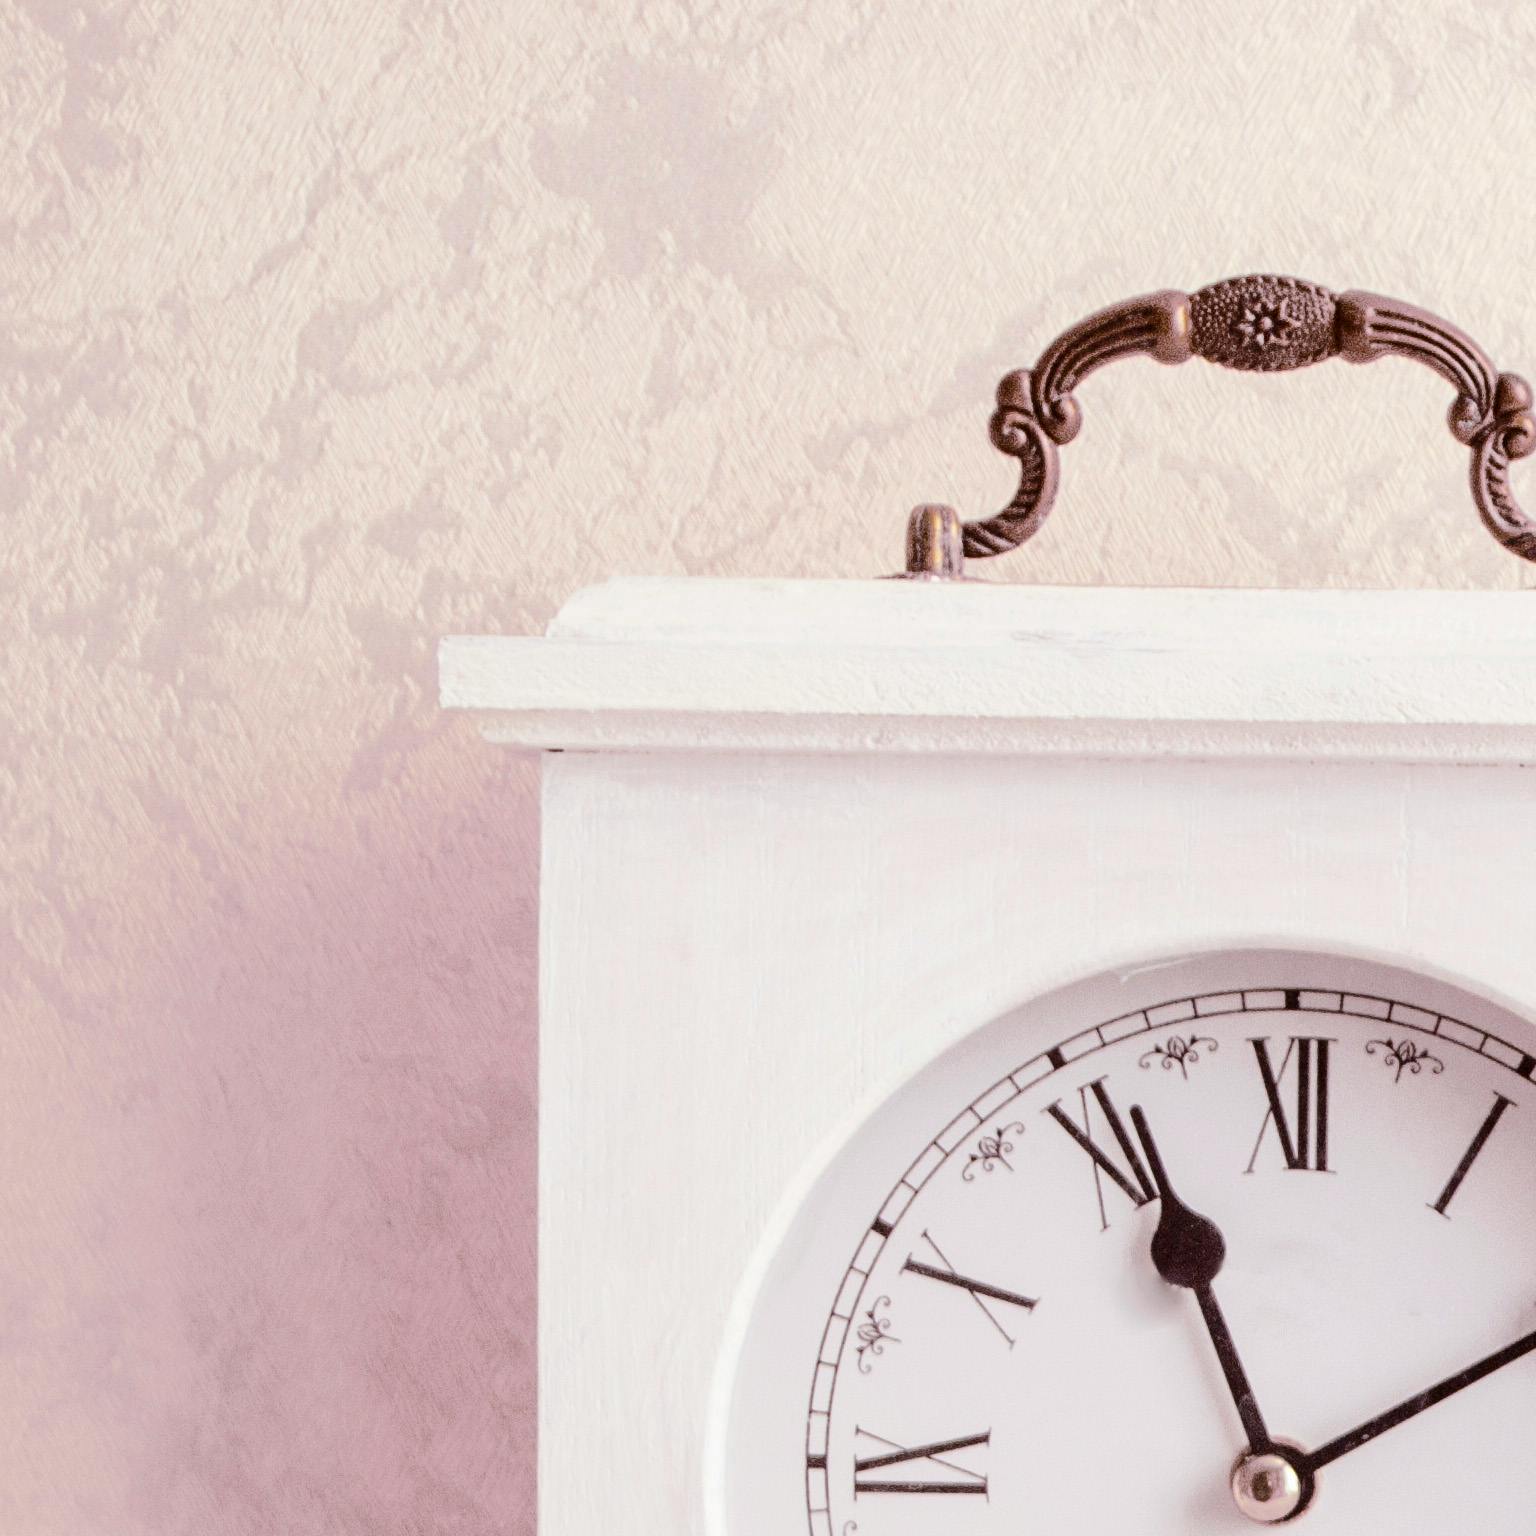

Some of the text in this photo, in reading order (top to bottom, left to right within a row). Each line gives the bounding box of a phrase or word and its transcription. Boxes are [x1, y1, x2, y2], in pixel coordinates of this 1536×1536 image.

[1040, 1075, 1161, 1232] XI
[1244, 1035, 1338, 1175] XII
[1426, 1090, 1519, 1219] I
[899, 1229, 1041, 1349] X
[854, 1425, 991, 1502] IX
